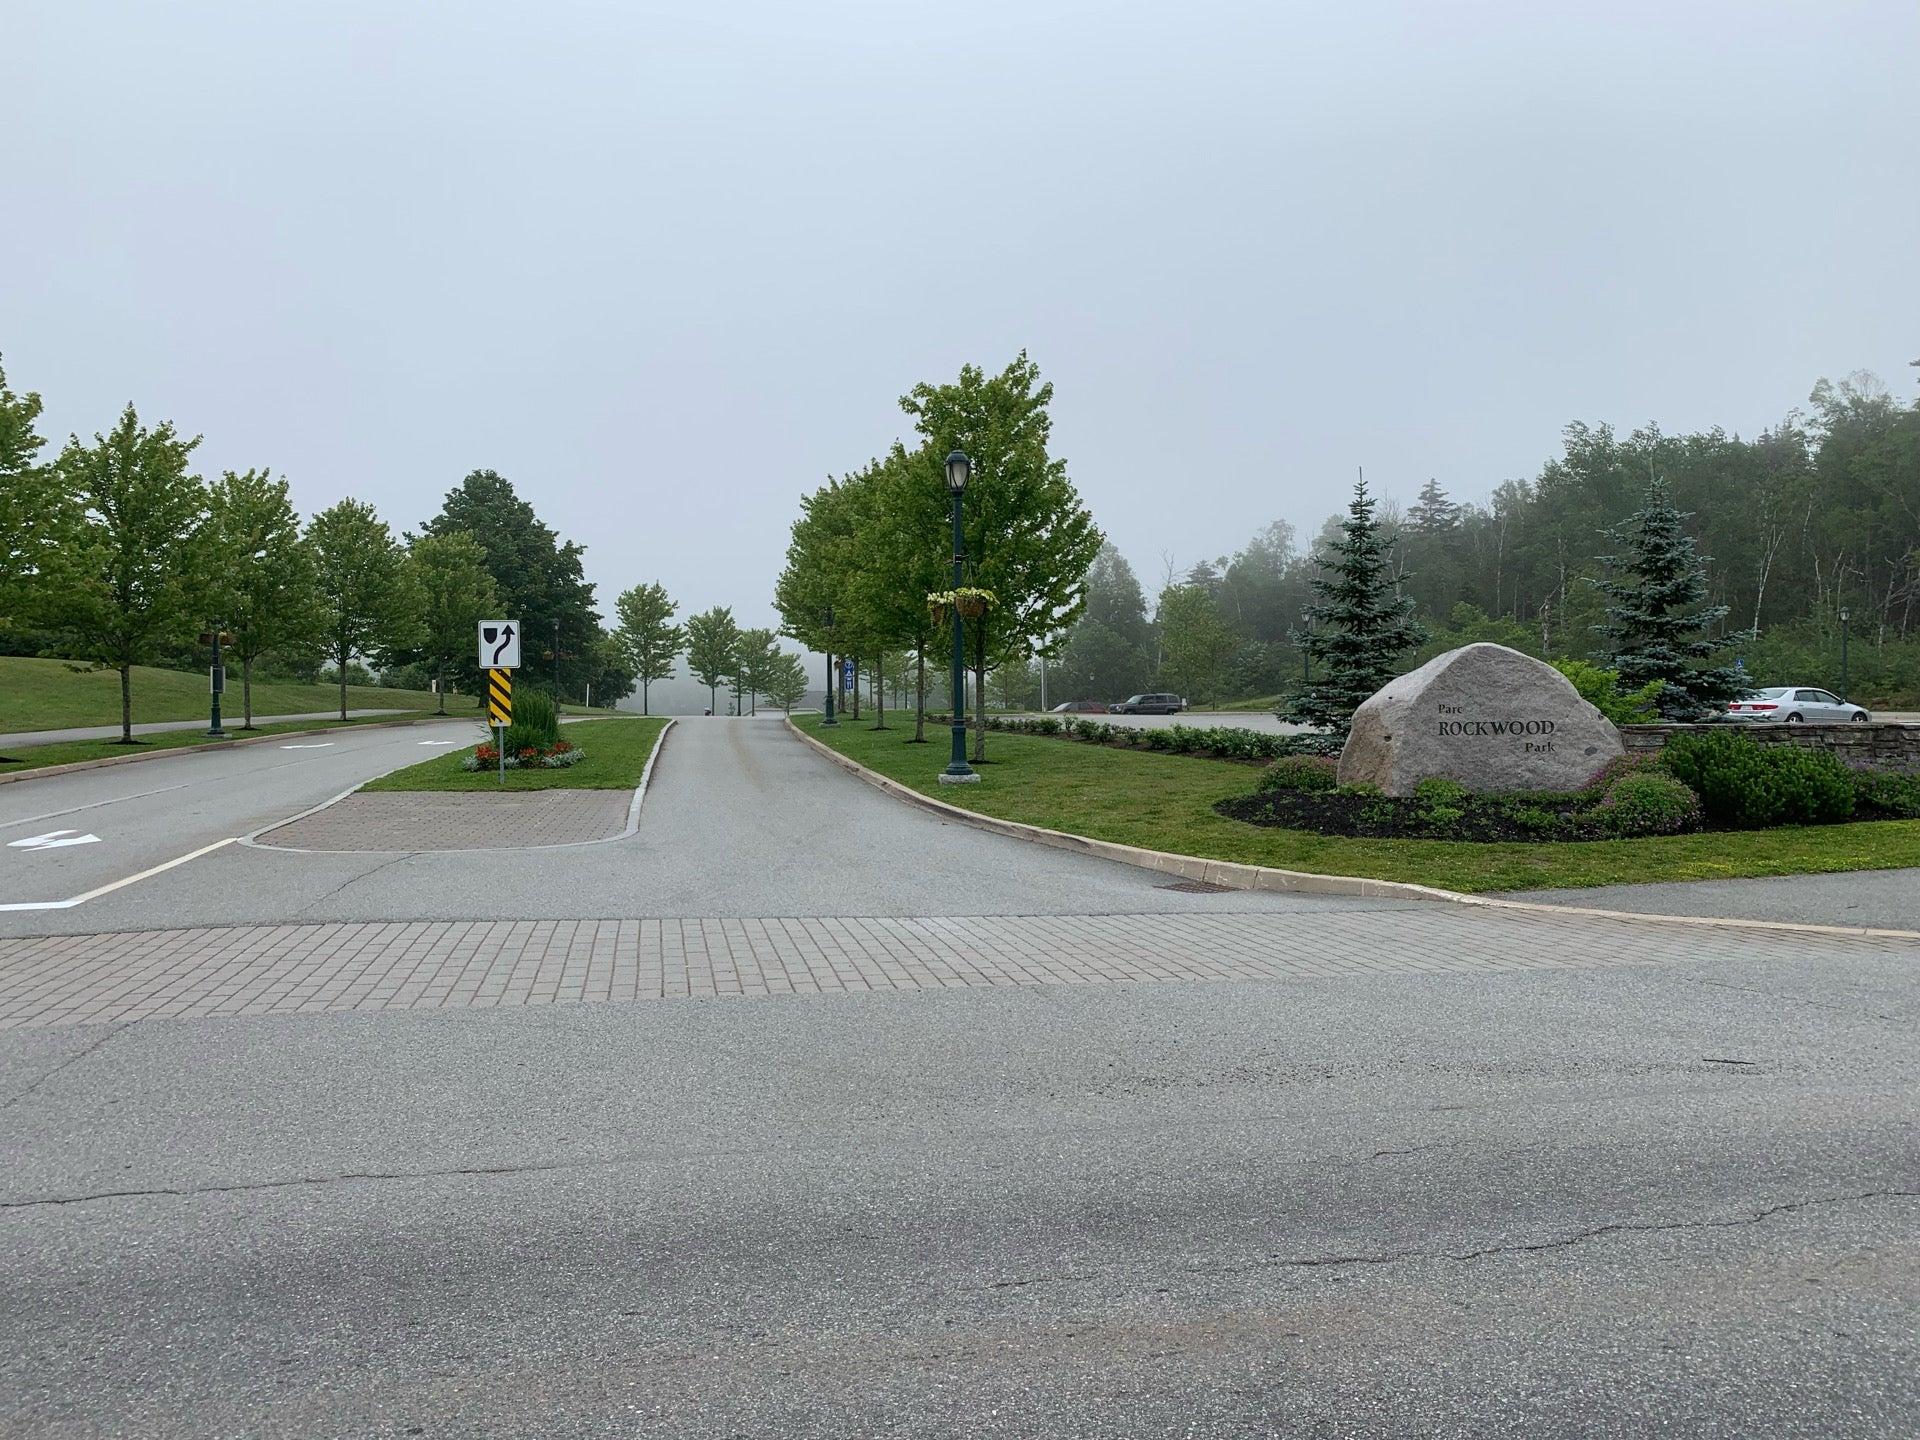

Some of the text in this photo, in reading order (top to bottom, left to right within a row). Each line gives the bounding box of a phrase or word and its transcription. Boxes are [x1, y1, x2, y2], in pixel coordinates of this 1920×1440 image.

[1438, 704, 1462, 714] Parc
[1438, 720, 1555, 736] ROCKWOOD
[1524, 742, 1556, 752] Park
